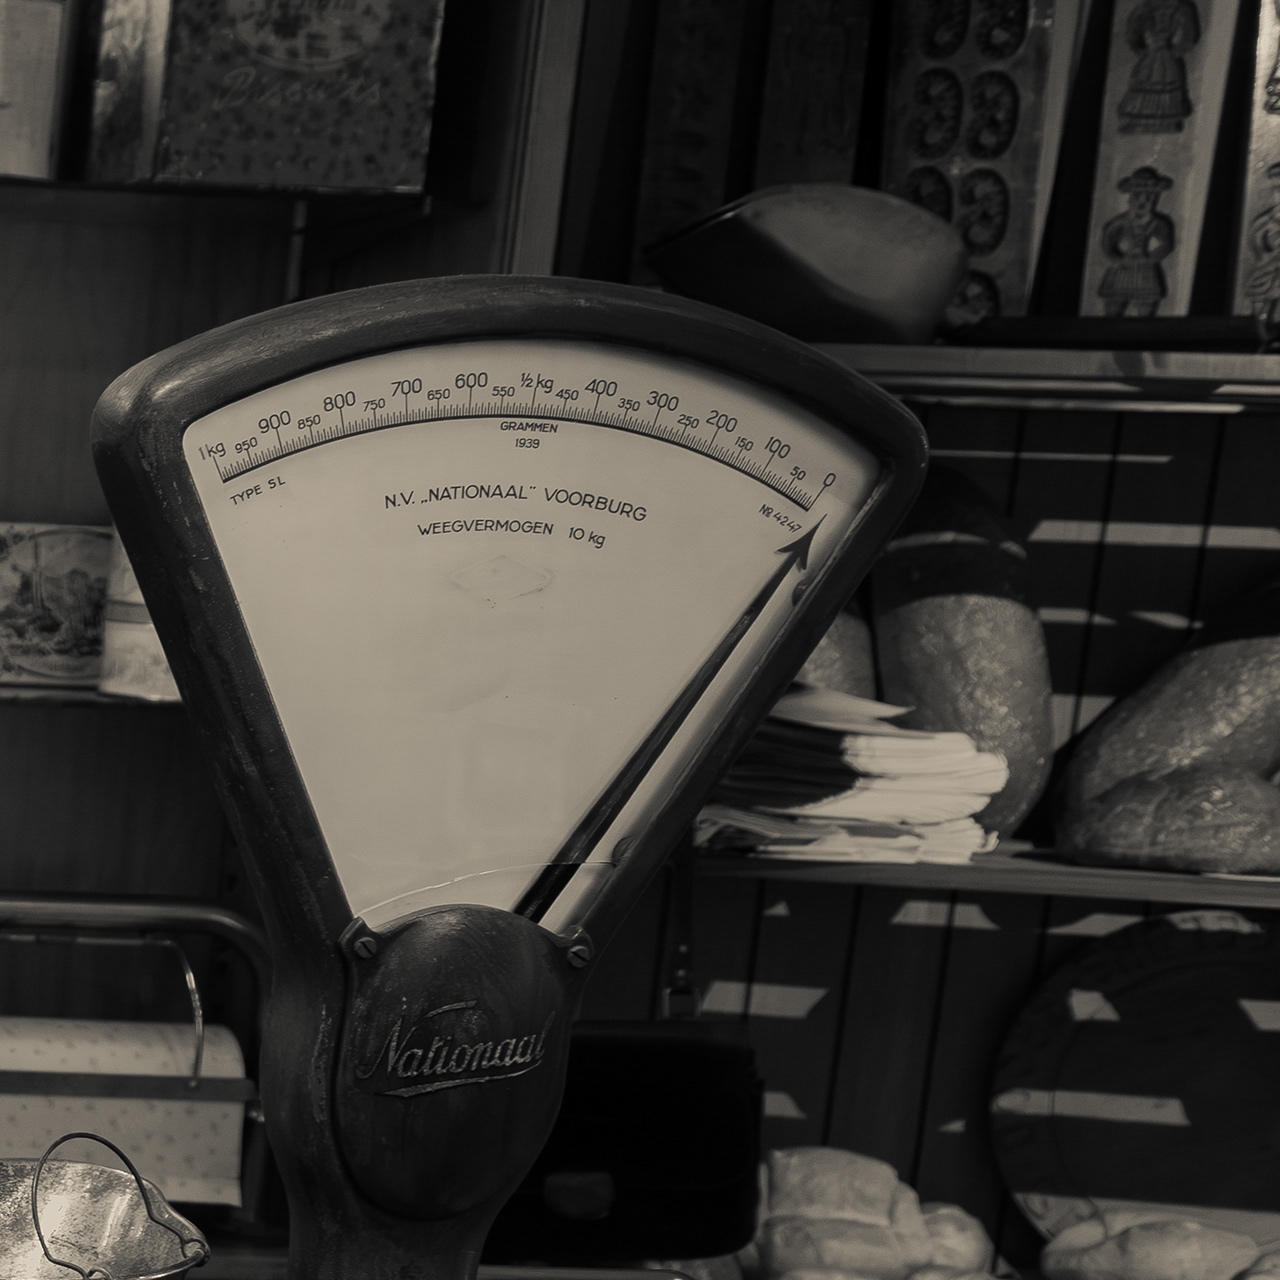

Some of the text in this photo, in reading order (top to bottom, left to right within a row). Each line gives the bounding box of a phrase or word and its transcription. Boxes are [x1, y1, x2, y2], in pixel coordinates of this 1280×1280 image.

[234, 436, 259, 454] 950
[258, 410, 292, 434] 900
[297, 414, 321, 430] 850
[323, 391, 356, 412] 800
[363, 398, 386, 412] 750
[390, 378, 423, 397] 700
[427, 388, 451, 401] 650
[455, 372, 488, 389] 600
[492, 386, 516, 397] 550
[555, 389, 579, 401] 450
[585, 378, 618, 397] 400
[617, 398, 641, 412] 350
[646, 390, 680, 412] 300
[677, 413, 700, 429] 250
[705, 410, 739, 433] 200
[734, 436, 755, 452] 150
[764, 436, 792, 459] 100
[790, 466, 807, 481] 50
[823, 472, 837, 487] 0
[500, 421, 558, 433] GRAMMEN
[515, 437, 541, 449] 1939
[230, 484, 263, 505] TYPE
[384, 490, 415, 509] N.V.
[543, 487, 648, 522] VOORBURG
[417, 519, 606, 549] WEEGVERMOGEN 10 kg
[773, 511, 803, 533] 4247
[356, 1001, 555, 1080] Nationaal
